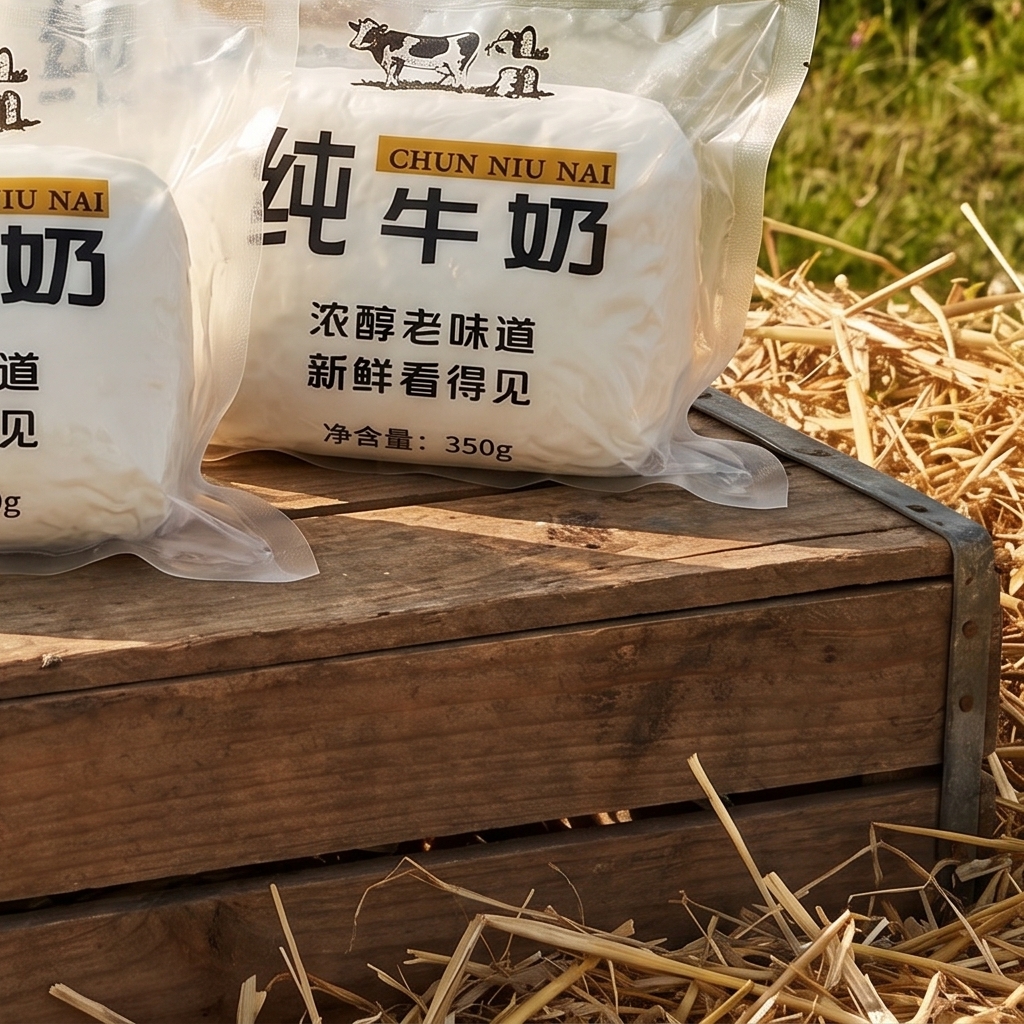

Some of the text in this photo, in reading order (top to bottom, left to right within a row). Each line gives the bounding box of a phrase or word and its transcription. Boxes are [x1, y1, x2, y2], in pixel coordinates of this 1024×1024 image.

[389, 148, 613, 186] CHUN NIU NAI
[48, 189, 105, 213] NAI
[262, 127, 610, 276] 纯牛奶
[309, 301, 536, 355] 浓醇老味道
[307, 352, 532, 406] 新鲜看得见
